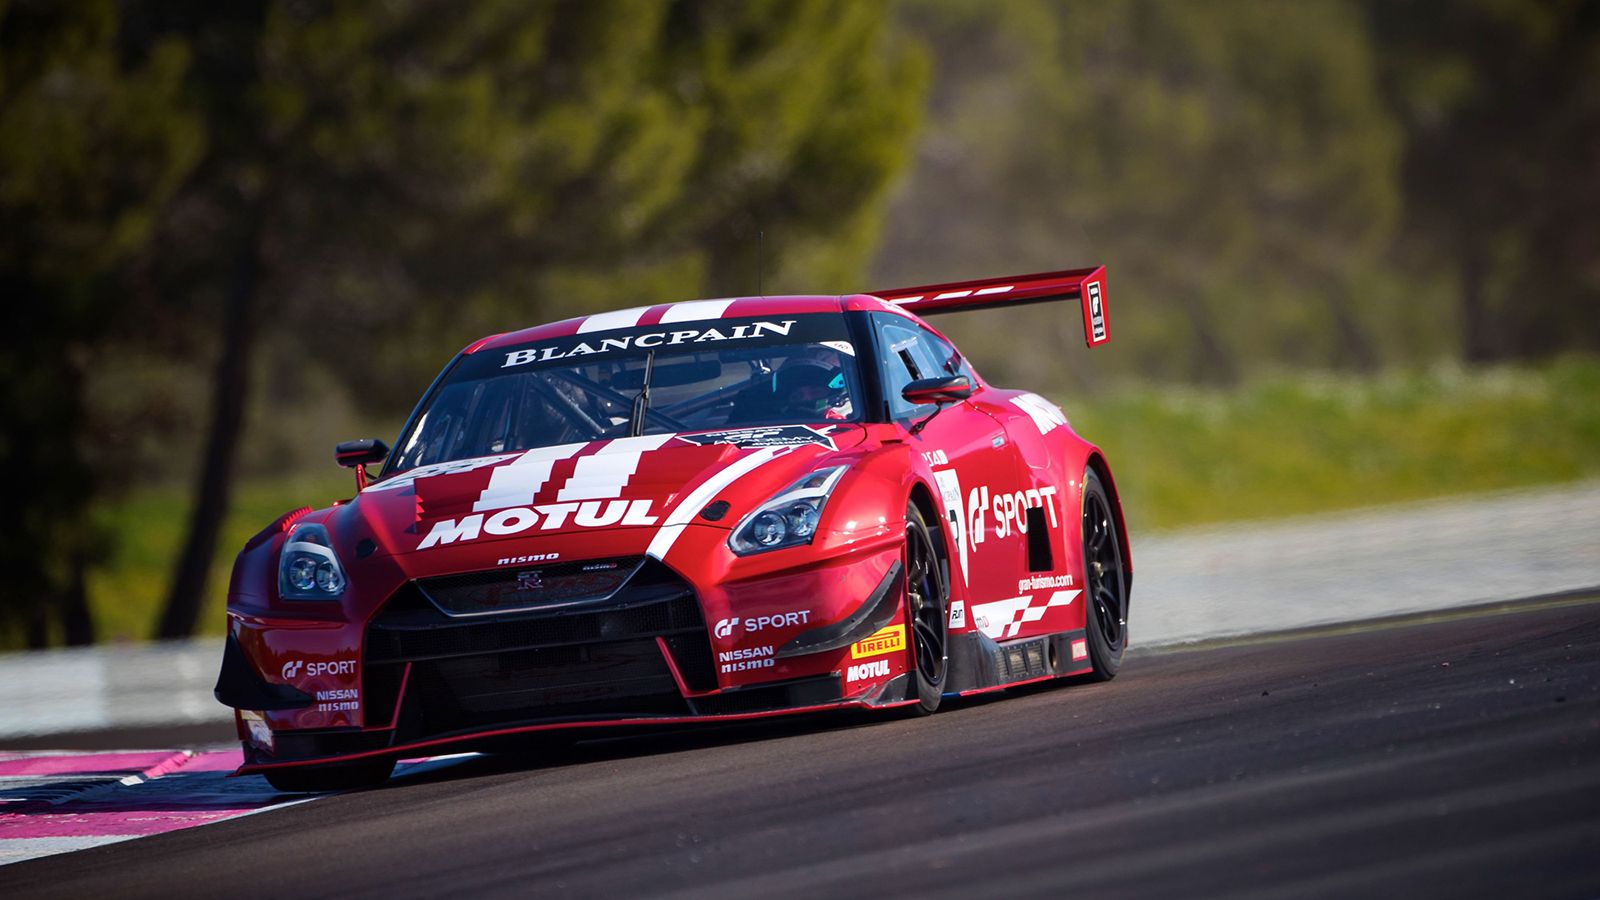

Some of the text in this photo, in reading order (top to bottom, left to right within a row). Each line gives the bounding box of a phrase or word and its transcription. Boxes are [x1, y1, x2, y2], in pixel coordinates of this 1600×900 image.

[501, 320, 796, 368] BLANCPAIN
[416, 500, 659, 550] MOTUL
[497, 553, 559, 565] nismo
[1018, 574, 1073, 594] gran-turismo.com
[744, 610, 810, 632] SPORT
[857, 631, 900, 654] PIRELLI
[719, 645, 774, 662] NISSAN
[307, 660, 357, 676] SPORT
[721, 658, 775, 673] nismo
[847, 660, 890, 682] MOTUL
[317, 689, 359, 701] NISSAN
[319, 701, 359, 712] nismo
